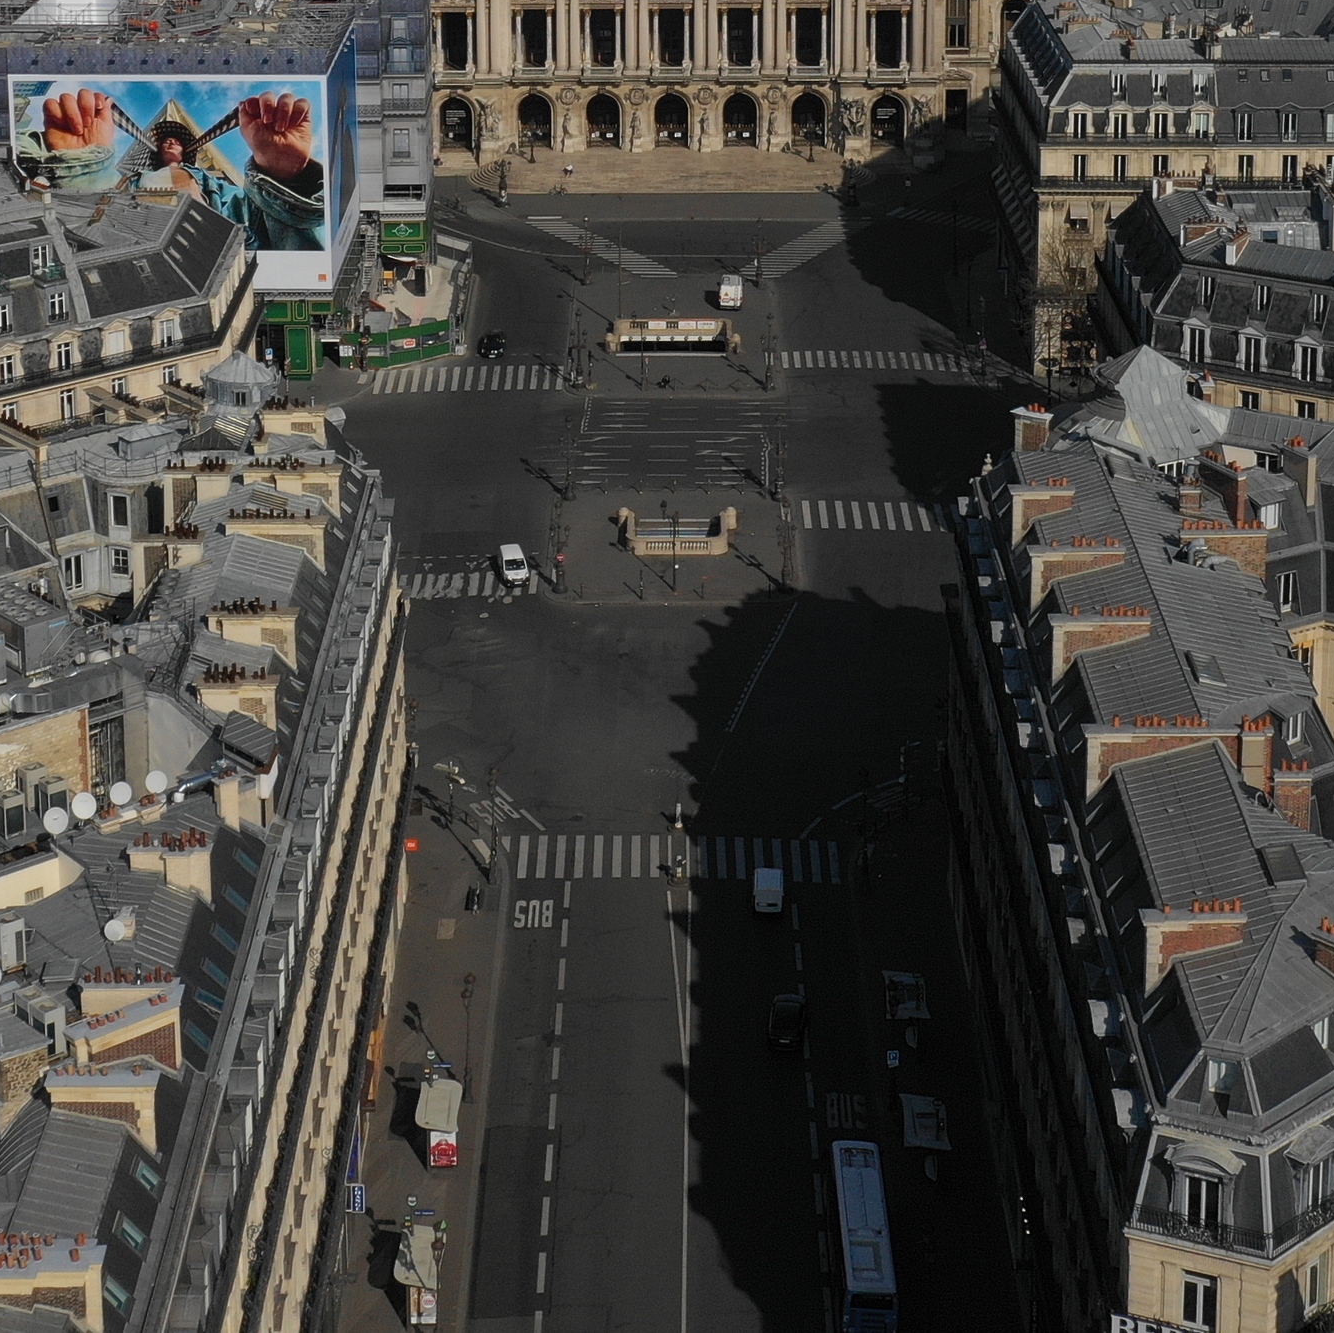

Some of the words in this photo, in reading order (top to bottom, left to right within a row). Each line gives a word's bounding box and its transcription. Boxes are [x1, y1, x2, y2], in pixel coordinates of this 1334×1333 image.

[468, 796, 522, 826] BUS
[513, 899, 554, 929] BUS
[826, 1091, 867, 1129] BUS
